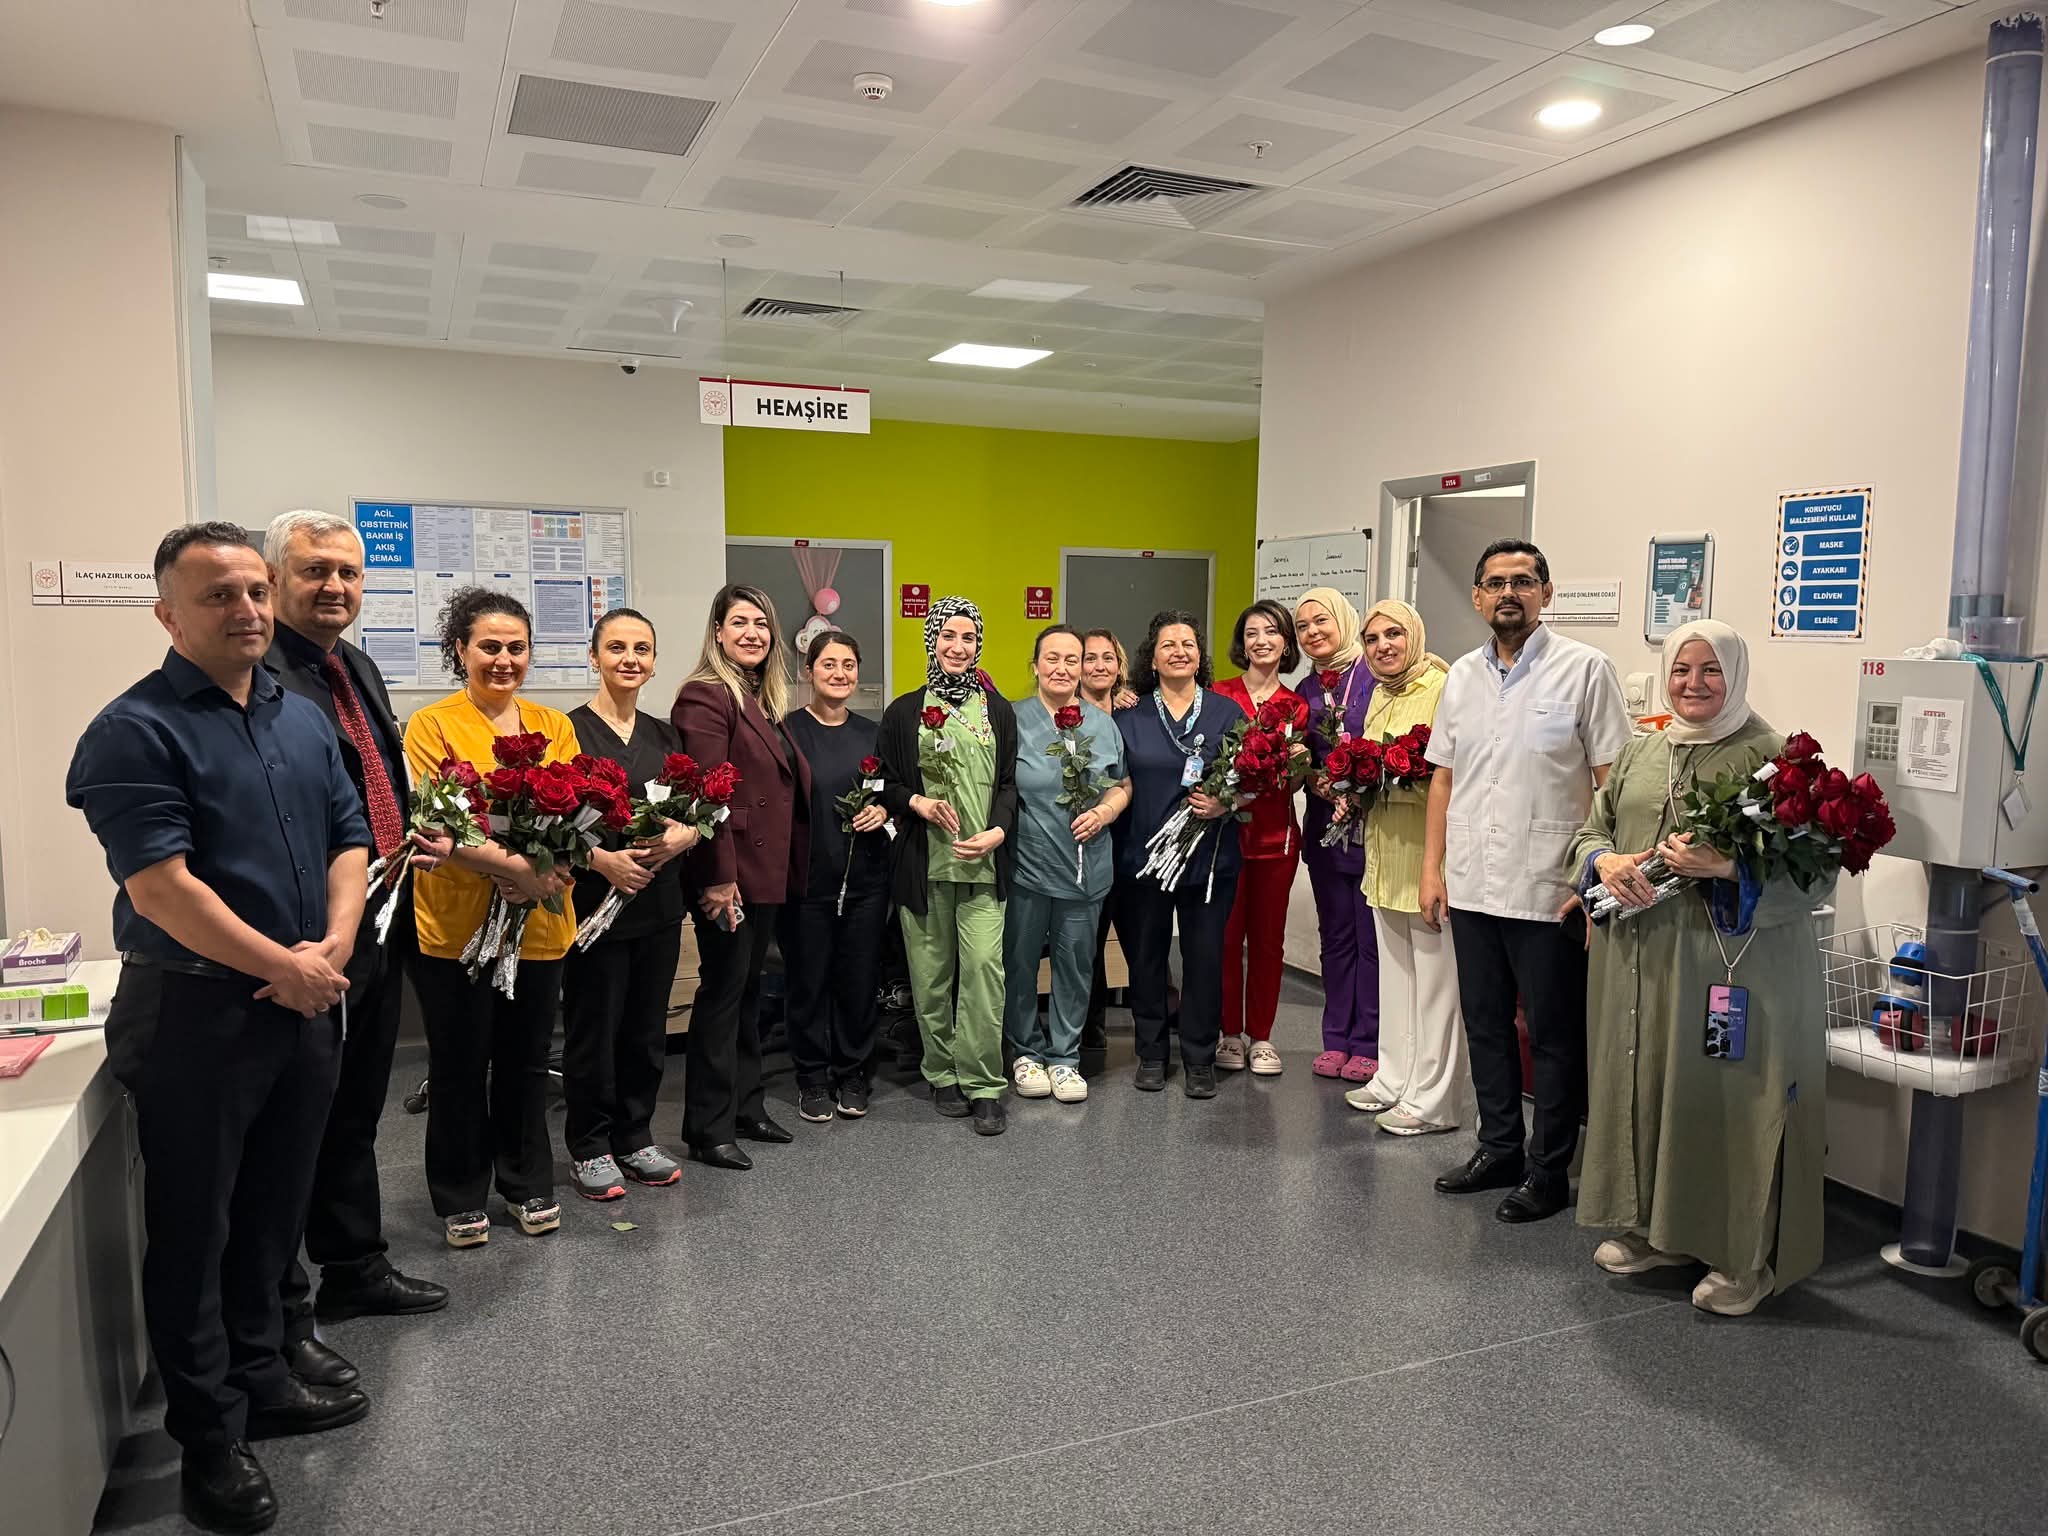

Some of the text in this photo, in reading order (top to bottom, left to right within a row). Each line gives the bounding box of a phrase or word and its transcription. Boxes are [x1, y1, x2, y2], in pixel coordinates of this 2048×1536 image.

[757, 396, 848, 423] HEMŞİRE
[374, 508, 395, 518] ACİL
[1804, 504, 1842, 514] KORUYUCU
[1789, 513, 1857, 525] MALZEMENİ KULLAN
[360, 520, 409, 529] OBSTETRİK
[366, 531, 404, 541] BAKIM İŞ
[375, 543, 395, 552] AKIŞ
[1819, 540, 1844, 549] MASKE
[369, 554, 402, 563] ŞEMASI
[1812, 566, 1847, 575] AYAKKABI
[75, 571, 94, 580] İLAÇ
[95, 572, 133, 580] HAZIRLIK
[1813, 591, 1843, 600] ELDİVEN
[1814, 616, 1838, 624] ELBİSE
[1862, 661, 1885, 676] 118
